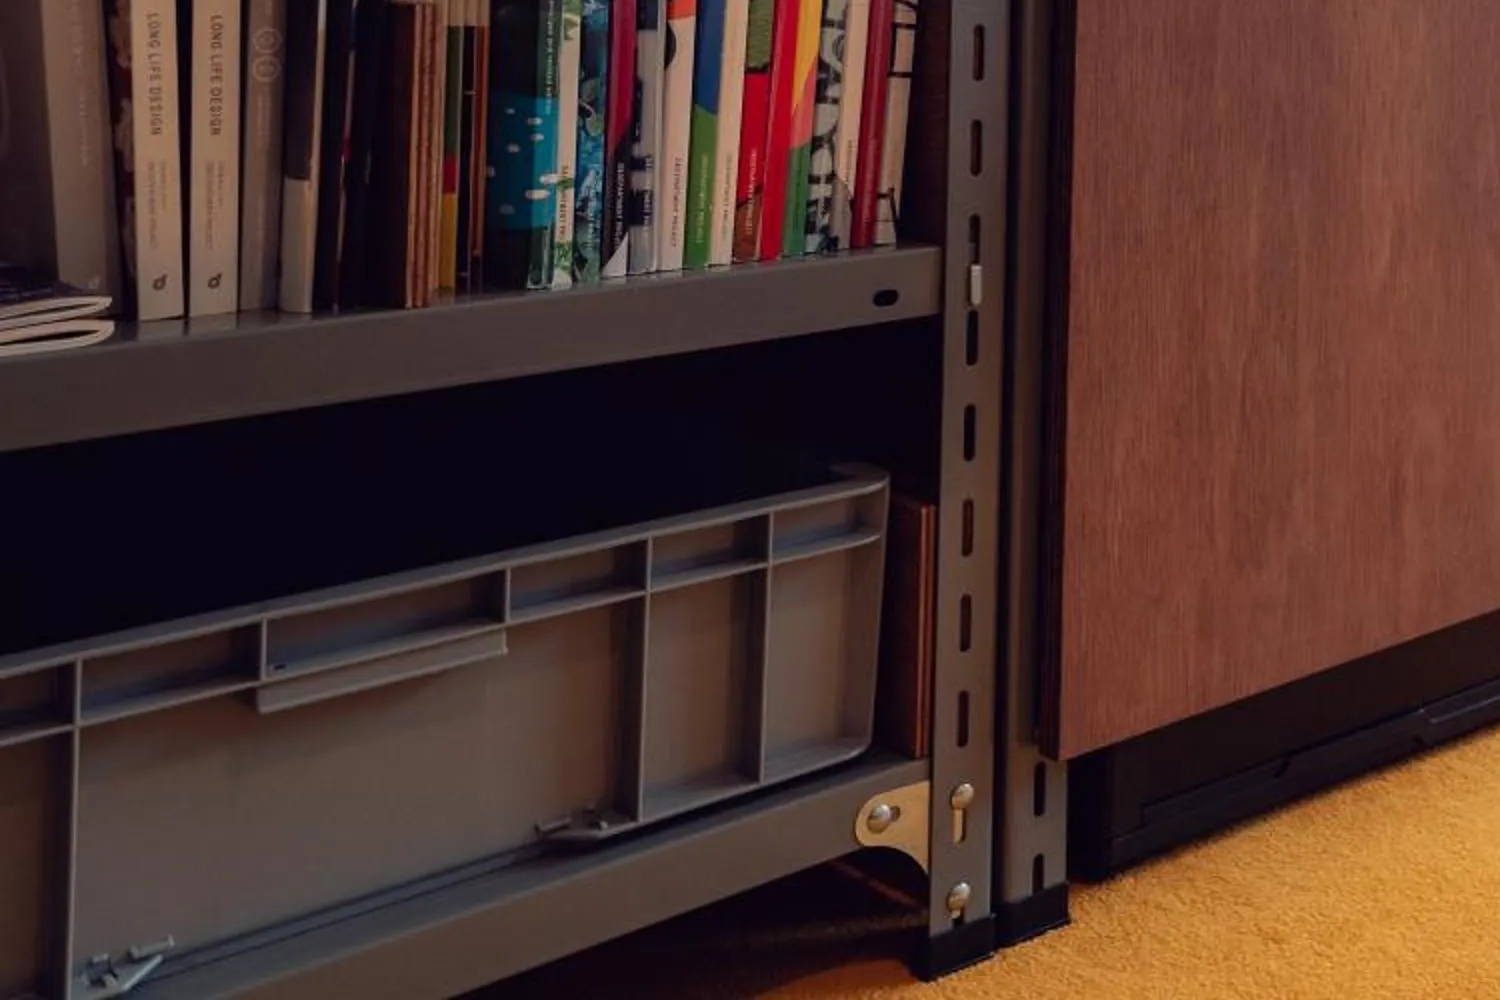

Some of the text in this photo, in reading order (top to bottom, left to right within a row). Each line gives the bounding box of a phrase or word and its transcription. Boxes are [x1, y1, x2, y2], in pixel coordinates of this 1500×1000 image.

[146, 13, 161, 48] LONG
[210, 14, 223, 49] LONG
[148, 53, 162, 81] LIFE
[210, 54, 223, 82] LIFE
[149, 86, 163, 136] DESIGN
[209, 87, 223, 136] DESIGN
